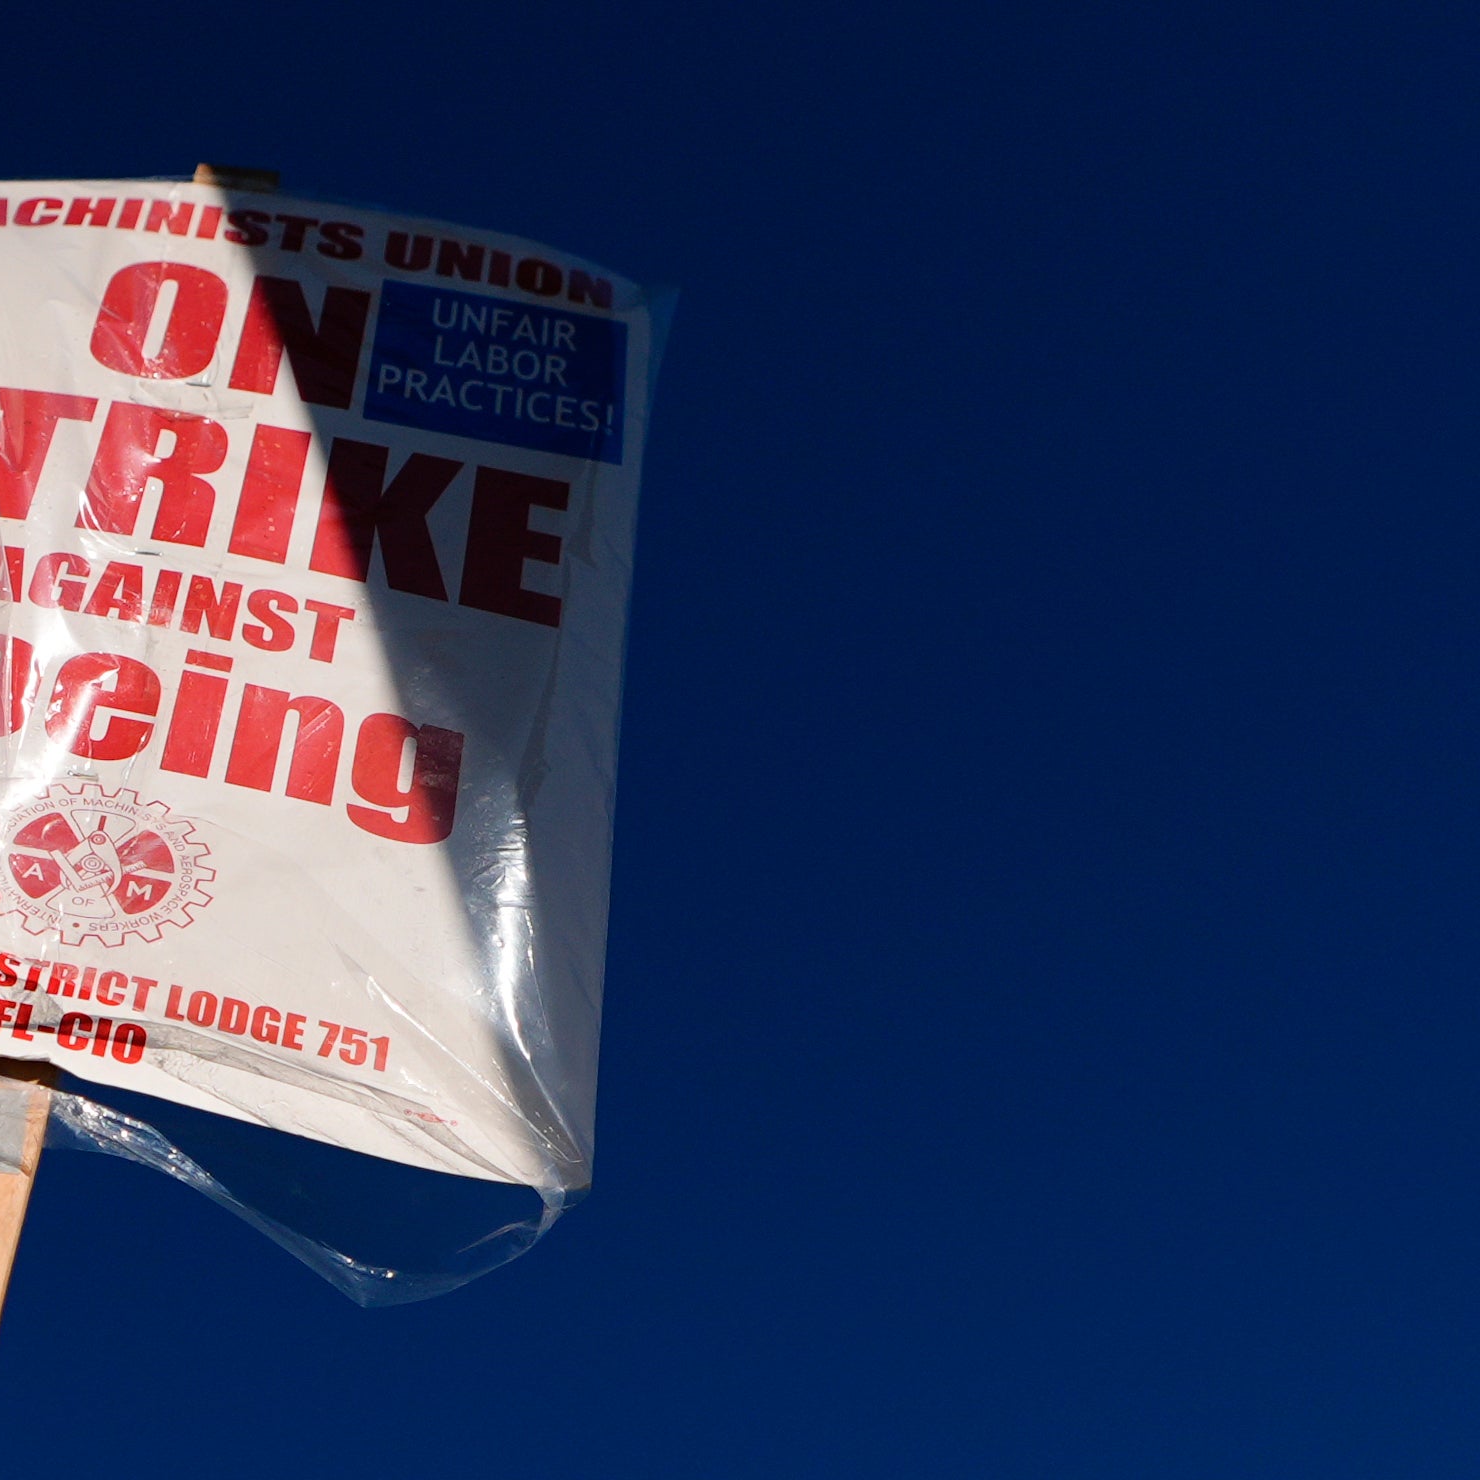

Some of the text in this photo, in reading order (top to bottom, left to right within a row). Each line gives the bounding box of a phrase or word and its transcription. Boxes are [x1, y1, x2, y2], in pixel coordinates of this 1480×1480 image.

[384, 232, 615, 309] UNION
[90, 261, 371, 409] ON
[431, 297, 578, 352] UNFAIR
[433, 334, 569, 388] LABOR
[376, 362, 615, 436] PRACTICES!
[58, 797, 79, 808] OF
[165, 831, 186, 852] AND
[71, 896, 96, 908] OF
[89, 910, 163, 932] WORKERS
[165, 985, 307, 1052] LODGE
[318, 1020, 390, 1072] 751
